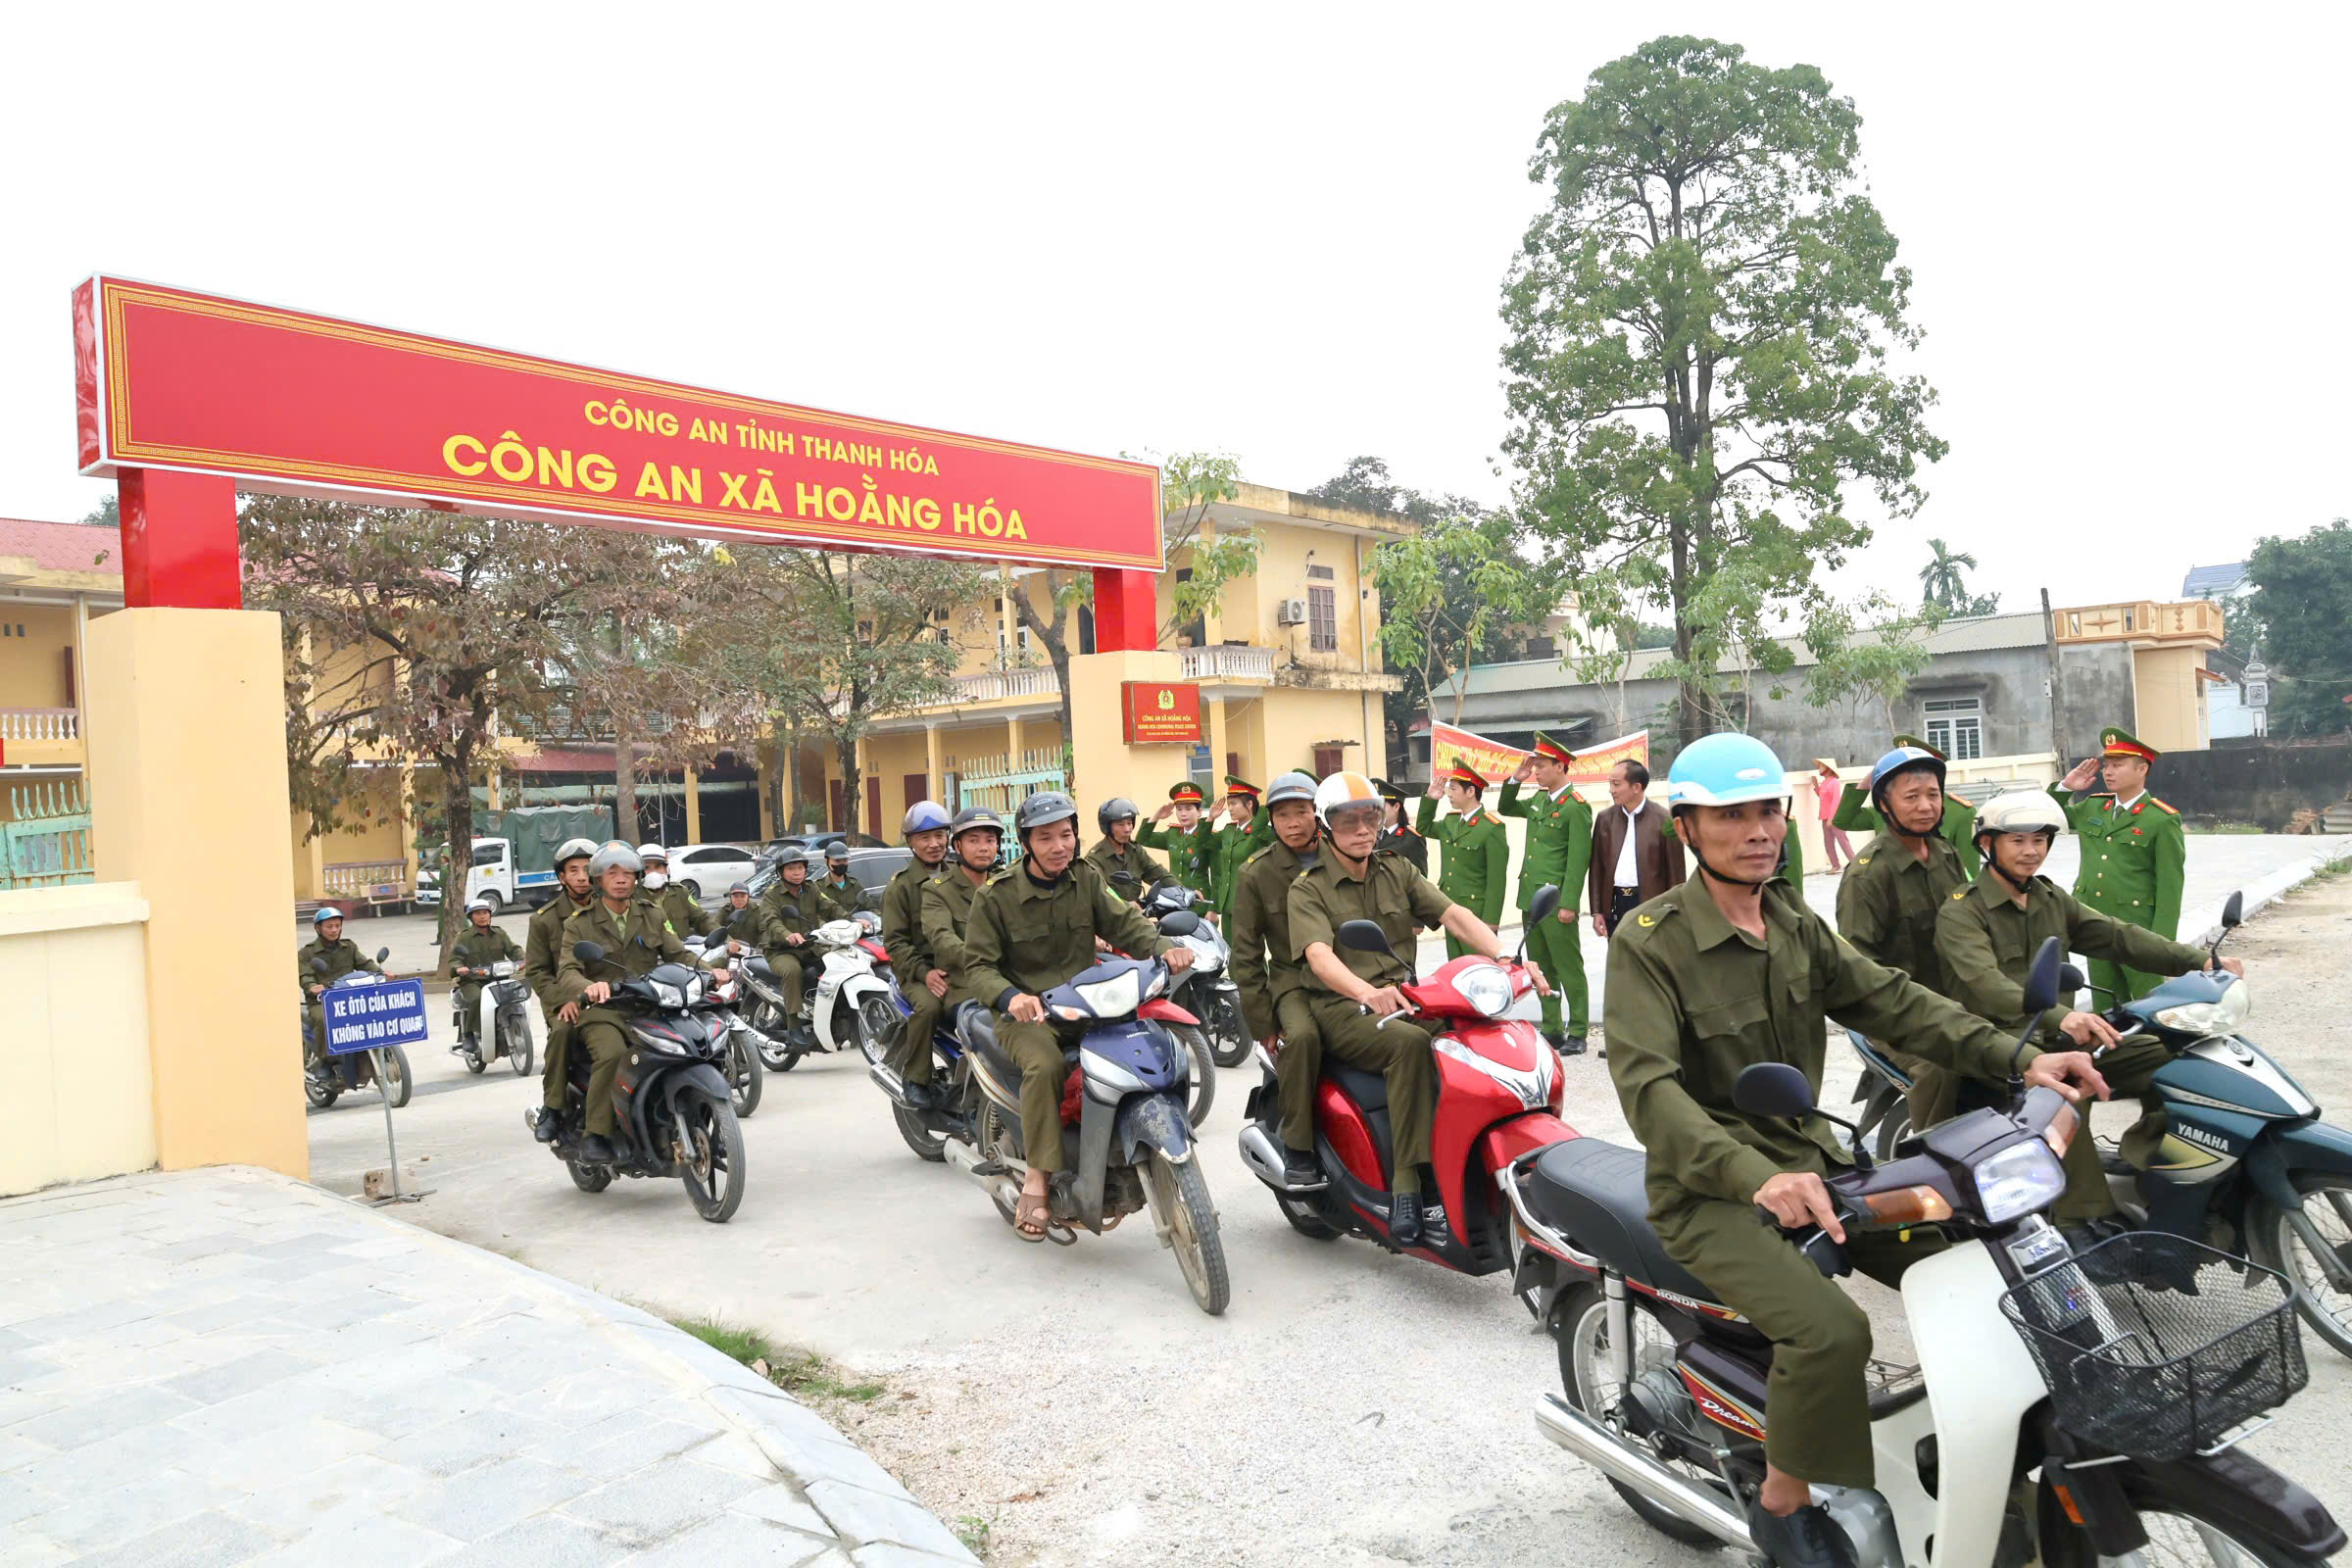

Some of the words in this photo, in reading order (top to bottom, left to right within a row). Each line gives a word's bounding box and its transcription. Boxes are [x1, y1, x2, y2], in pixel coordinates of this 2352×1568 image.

[584, 398, 679, 437] CÔNG
[688, 417, 728, 445] AN
[735, 418, 795, 456] TỈNH
[801, 434, 882, 468] THANH
[890, 447, 940, 476] HÓA
[443, 430, 617, 492] CÔNG
[635, 462, 703, 504] AN
[718, 468, 783, 514] XÃ
[796, 473, 942, 530] HOẰNG
[953, 497, 1028, 540] HÓA
[333, 1001, 347, 1017] XE
[348, 995, 367, 1015] ÔTÔ
[368, 991, 387, 1012] CỦA
[387, 990, 416, 1009] KHÁCH
[332, 1023, 366, 1044] KHÔNG
[367, 1019, 385, 1039] VÀO
[386, 1018, 399, 1036] CƠ
[2178, 1122, 2230, 1152] YAMAHA
[1656, 1289, 1699, 1309] HONDA
[1699, 1396, 1759, 1429] Dream
